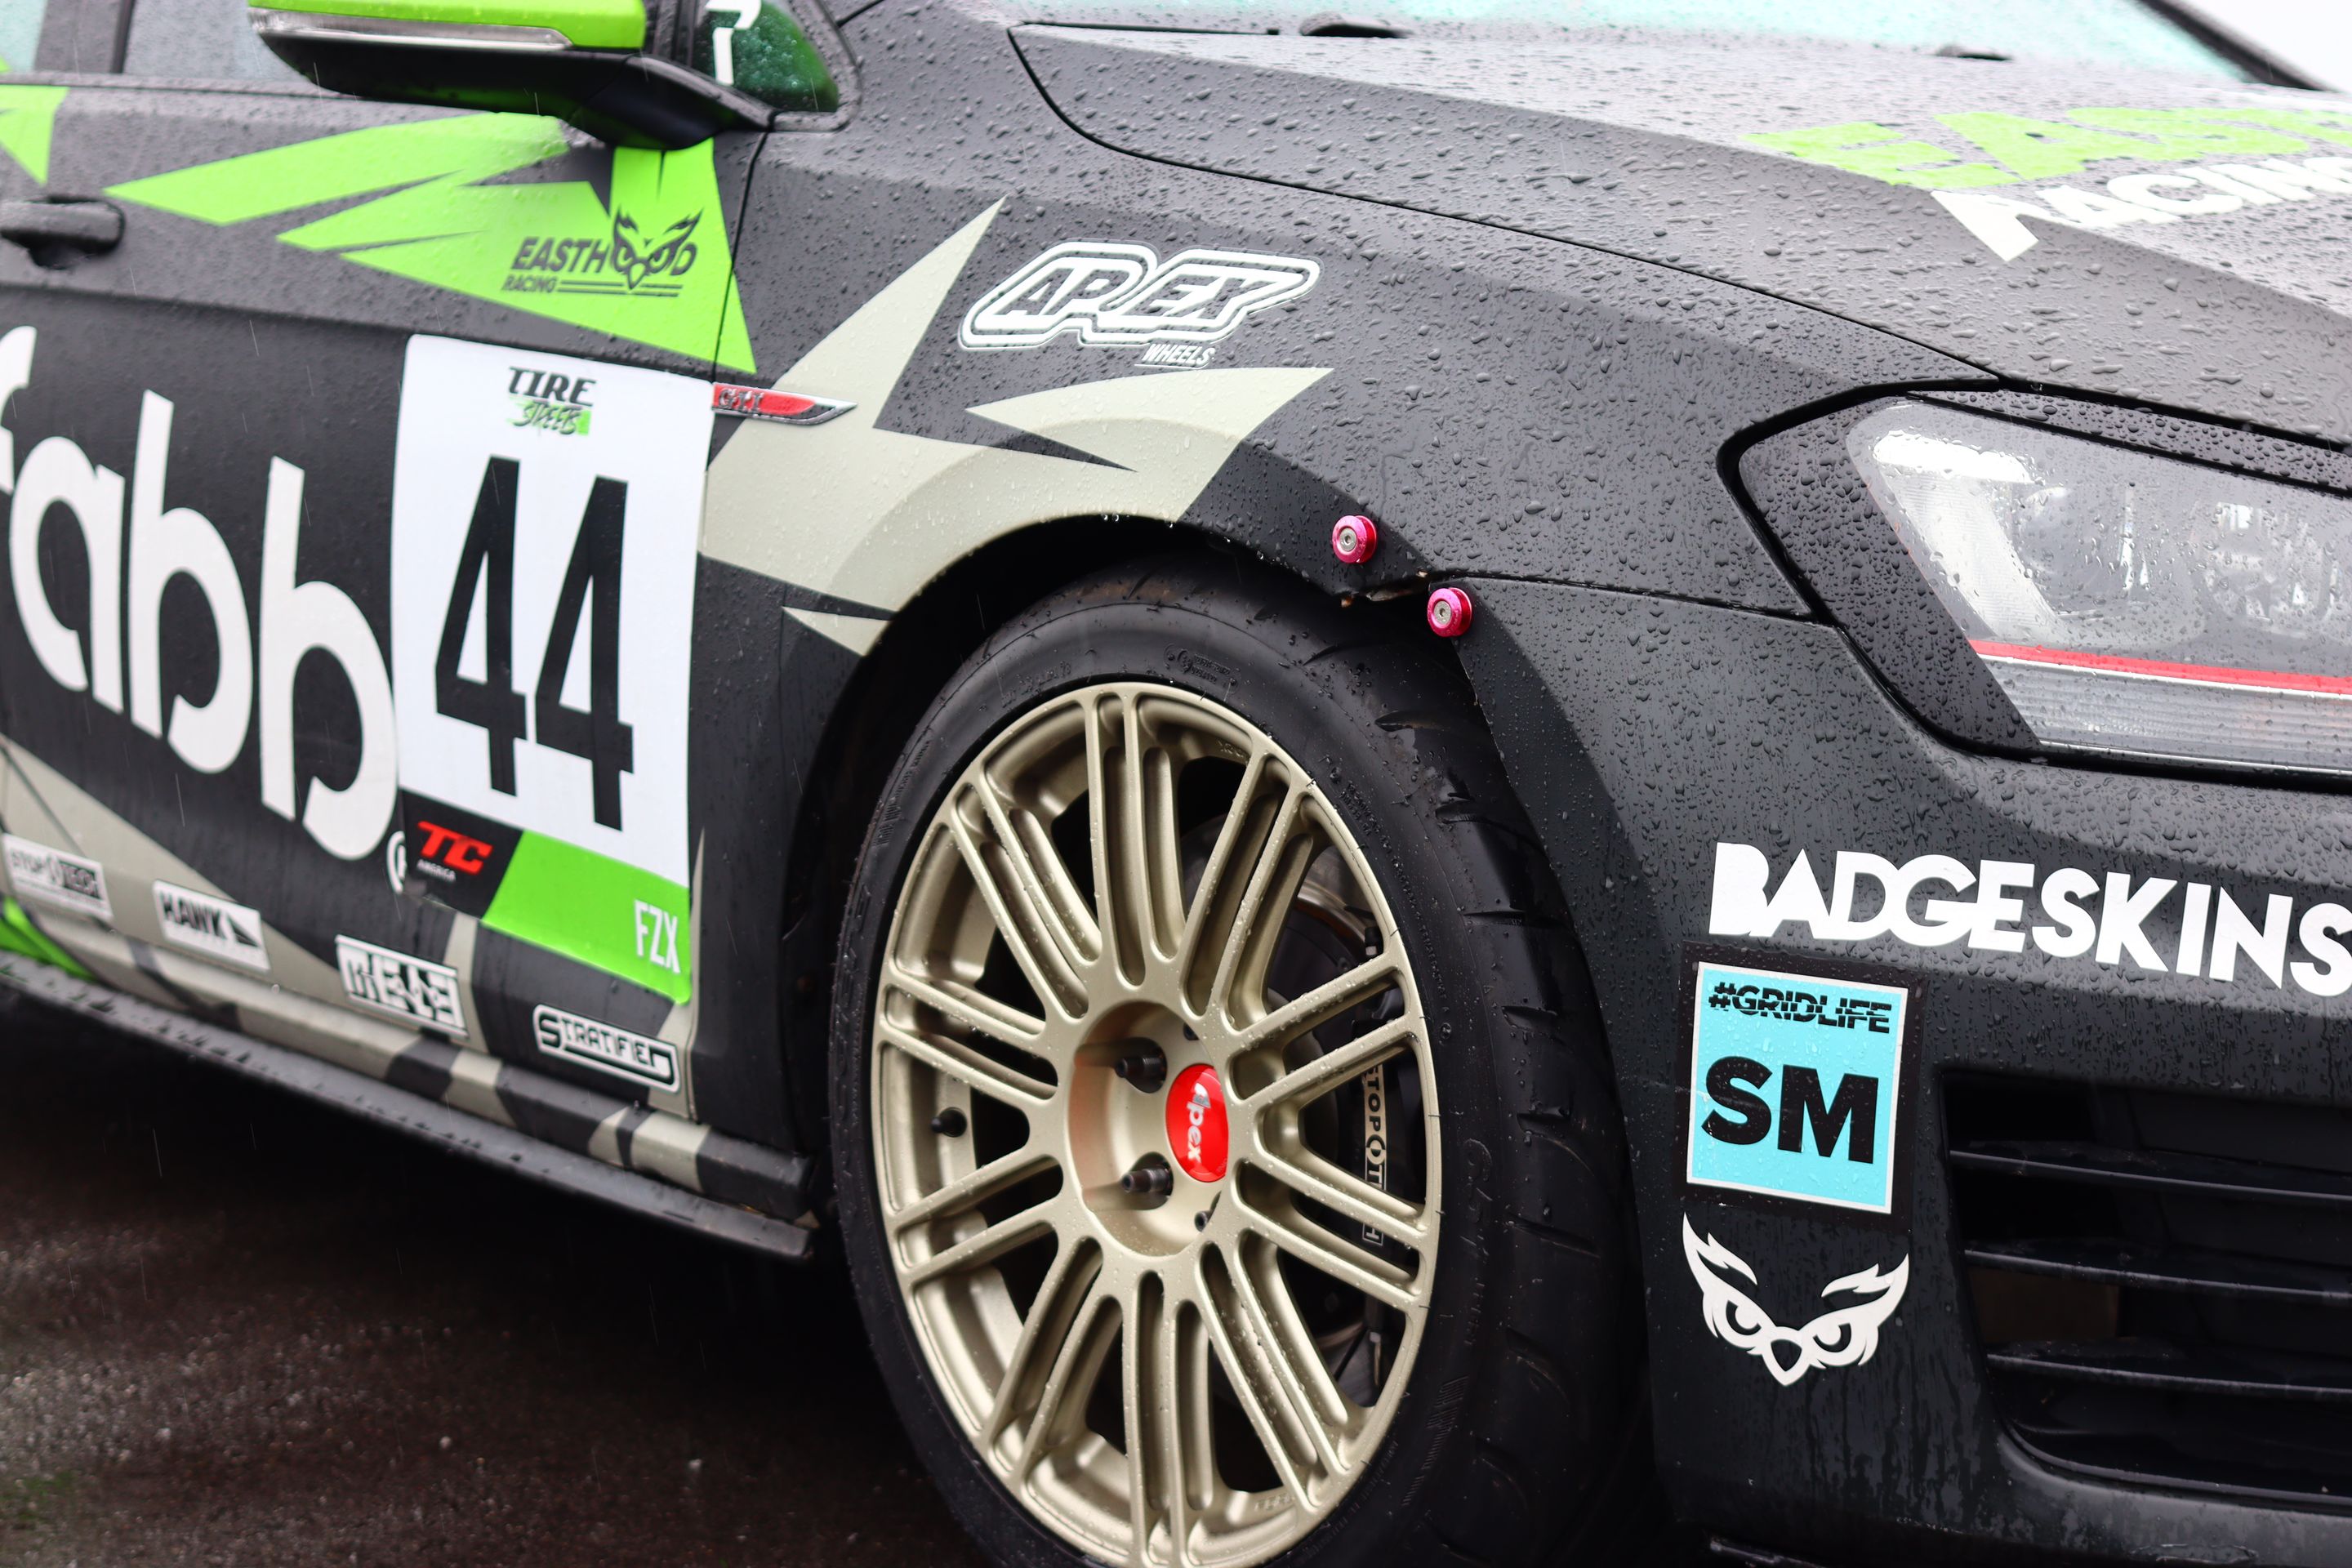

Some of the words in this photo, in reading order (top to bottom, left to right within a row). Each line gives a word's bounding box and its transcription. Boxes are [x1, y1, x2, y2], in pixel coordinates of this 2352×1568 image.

[501, 275, 559, 294] RACING
[1142, 343, 1217, 366] WHEELS
[508, 365, 597, 408] TIRE
[434, 455, 635, 832] 44
[417, 820, 494, 875] TC
[159, 892, 229, 940] HAWK
[634, 898, 681, 974] FZX
[1708, 842, 2352, 997] BADGESKINS
[1708, 982, 1892, 1034] #GRIDLIFE
[1701, 1056, 1879, 1165] SM
